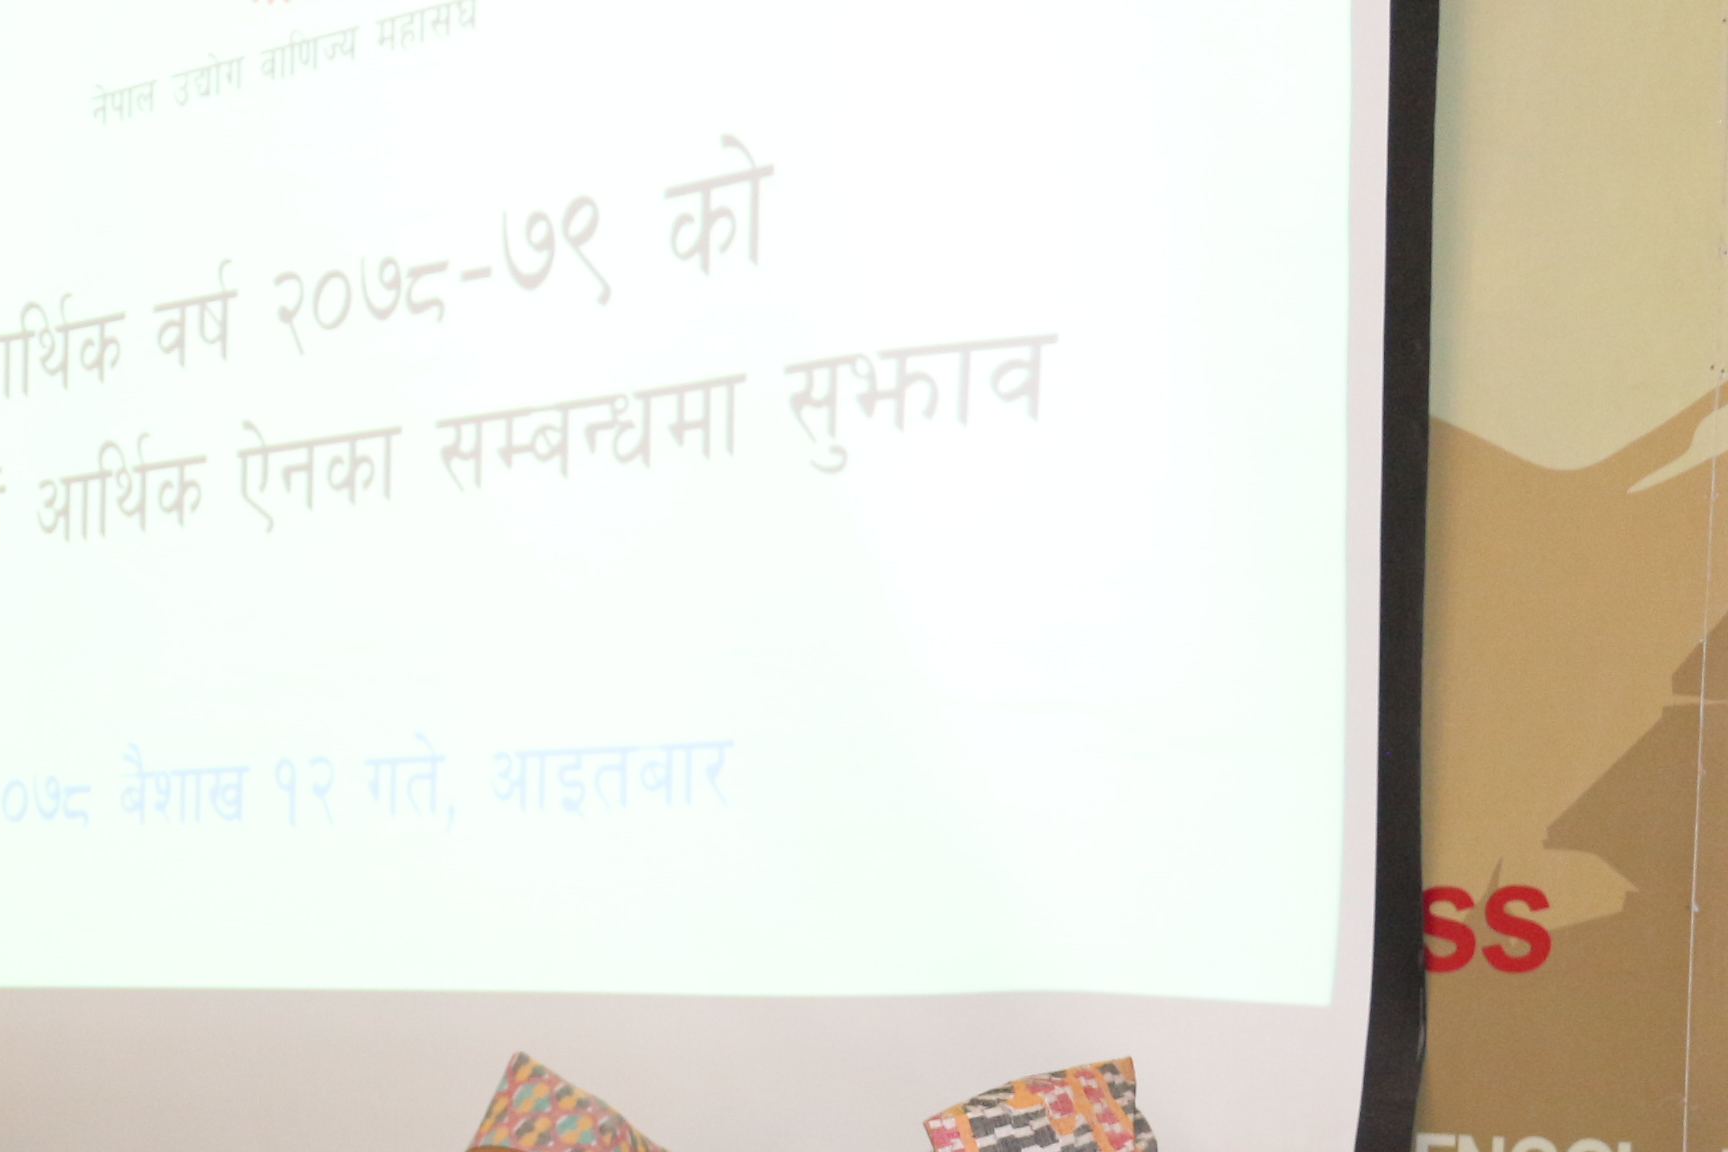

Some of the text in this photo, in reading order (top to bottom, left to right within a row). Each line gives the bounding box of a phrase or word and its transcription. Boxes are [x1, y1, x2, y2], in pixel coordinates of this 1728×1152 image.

[92, 80, 157, 125] नेपाल
[172, 53, 245, 107] उद्योग
[261, 26, 360, 81] वाणिज्य
[153, 257, 239, 369] वर्ष
[662, 133, 776, 277] को
[36, 431, 209, 543] आर्थिक
[235, 419, 403, 534] ऐनका
[434, 372, 748, 493] सम्बन्धमा
[273, 754, 335, 828] १२
